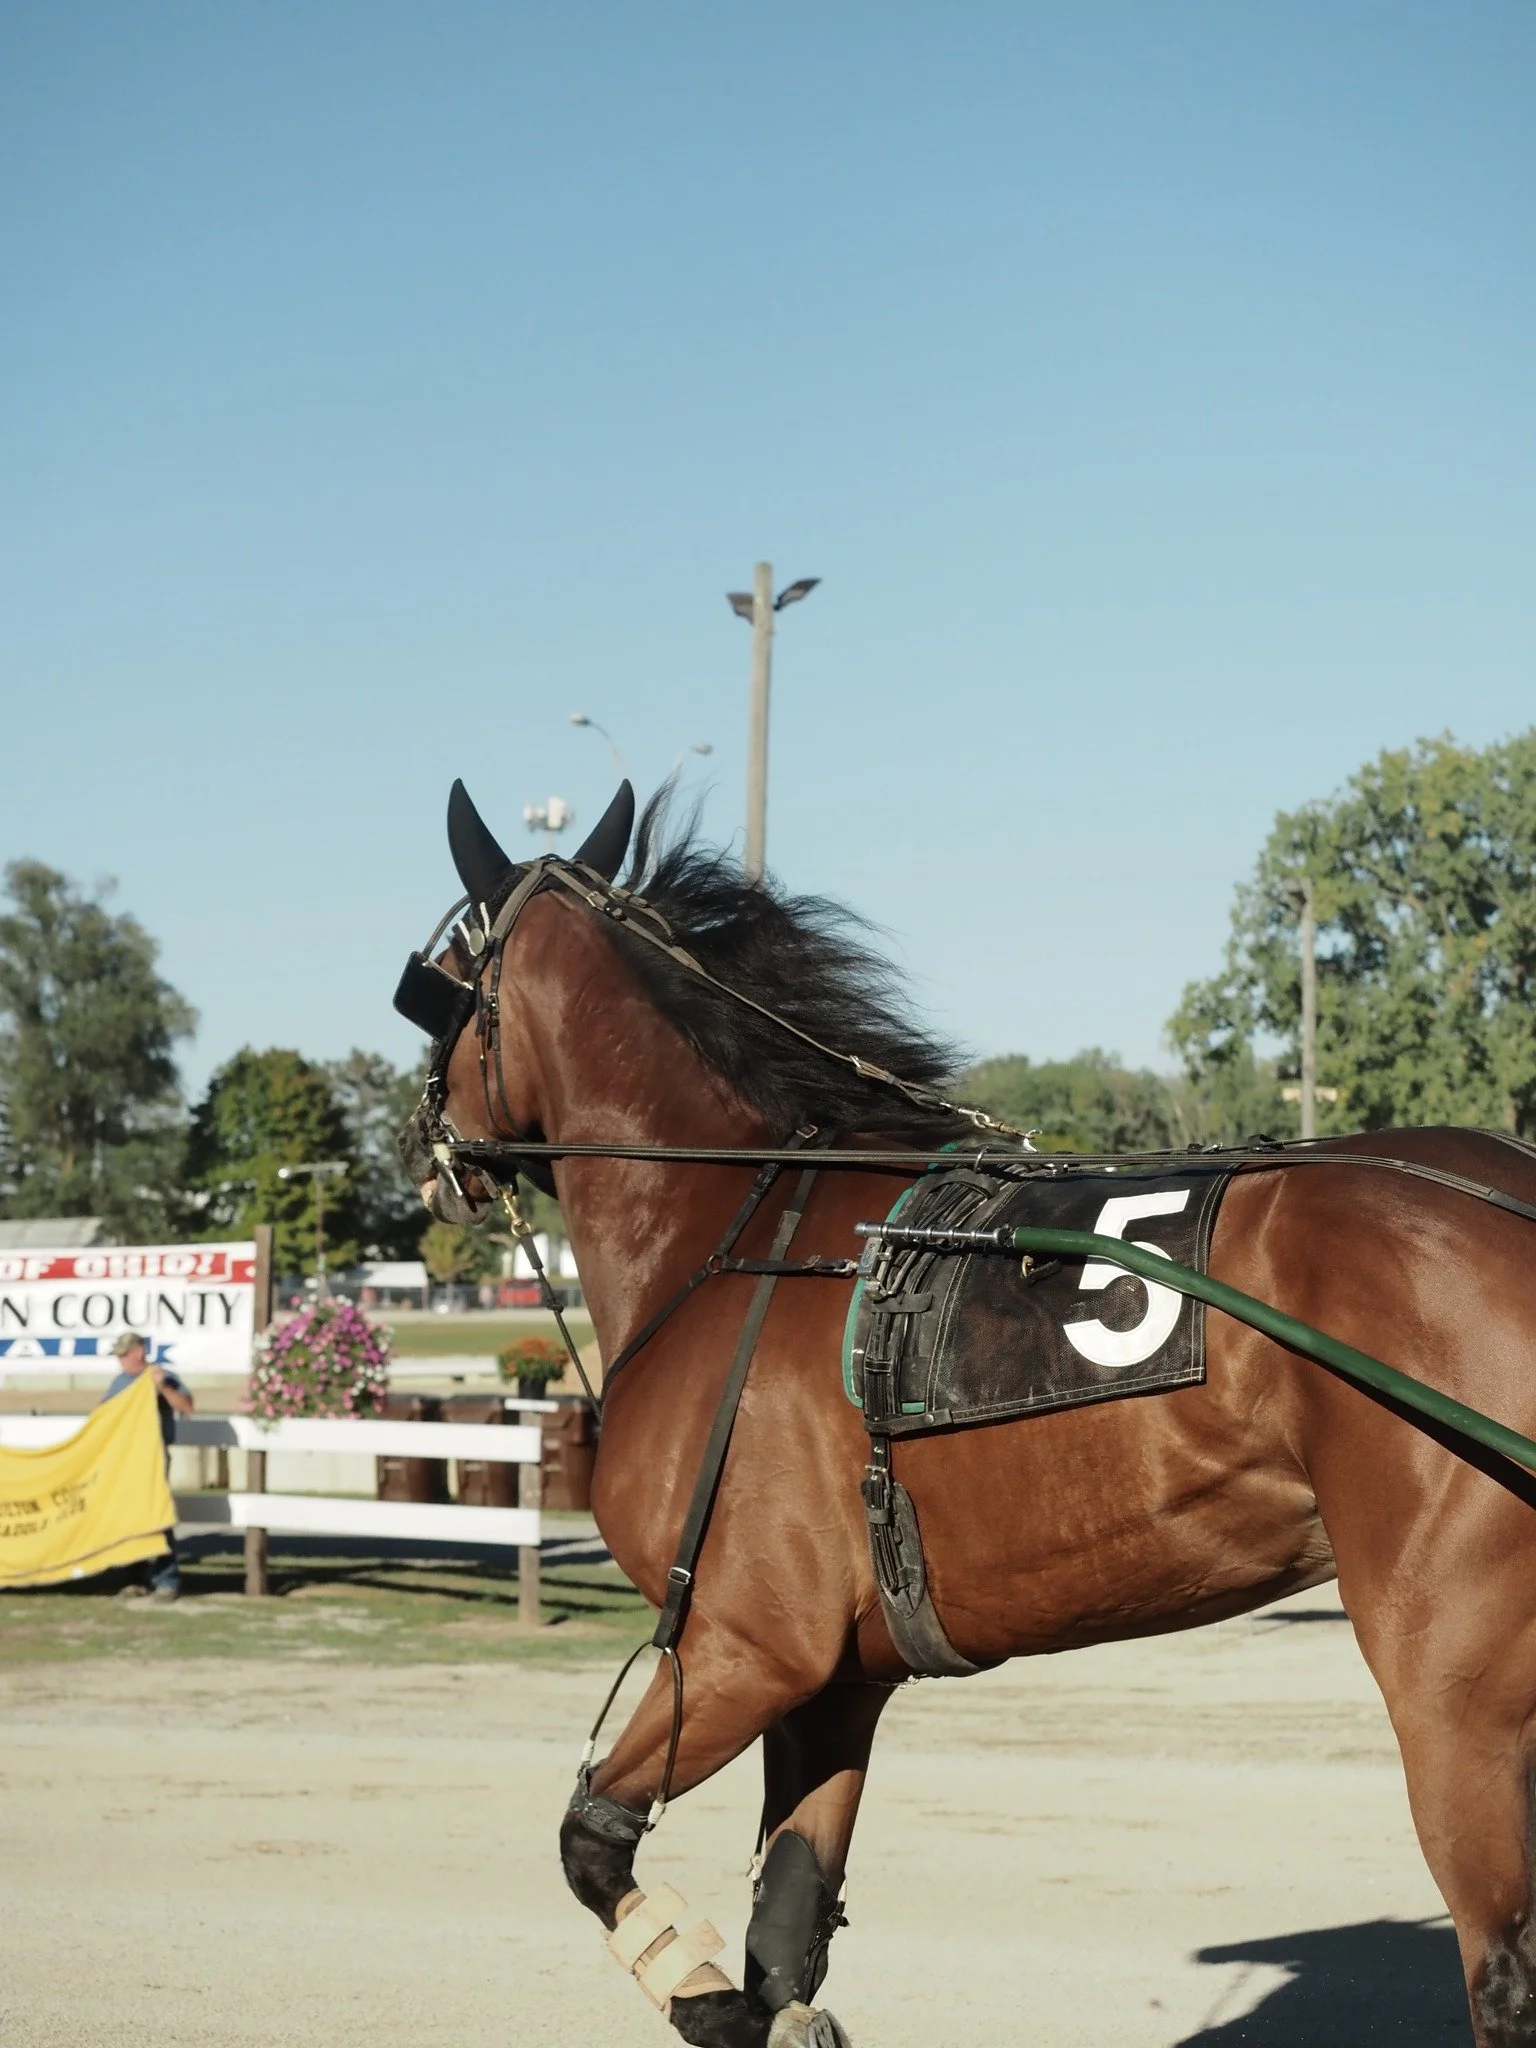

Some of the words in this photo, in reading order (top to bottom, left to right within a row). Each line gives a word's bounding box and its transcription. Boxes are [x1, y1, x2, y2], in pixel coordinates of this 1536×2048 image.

[0, 1256, 54, 1280] OF
[1064, 1190, 1190, 1367] 5
[52, 1292, 240, 1328] COUNTY
